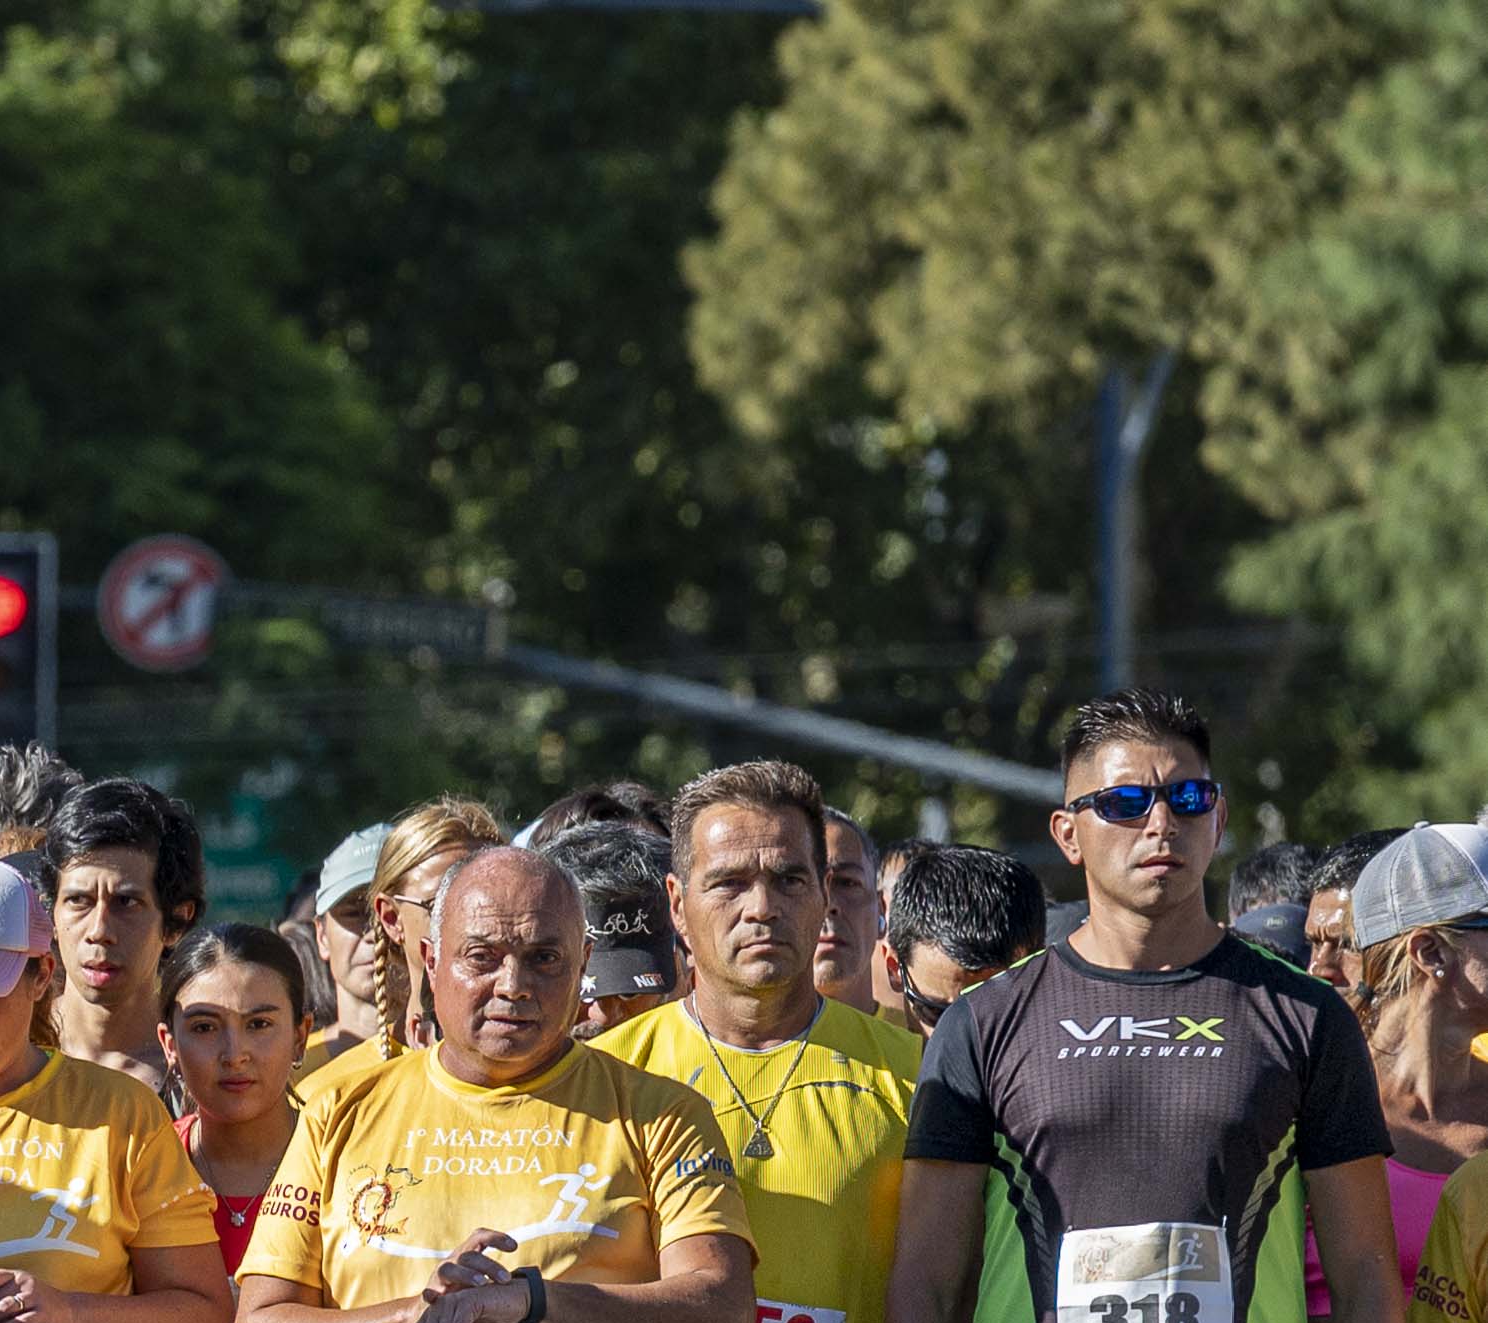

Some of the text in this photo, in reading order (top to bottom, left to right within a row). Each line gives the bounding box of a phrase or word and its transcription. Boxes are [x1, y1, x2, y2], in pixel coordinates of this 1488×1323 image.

[1059, 1016, 1226, 1041] VKX
[1057, 1045, 1226, 1060] SPORTSWEAR
[433, 1123, 576, 1149] MARATÓN
[421, 1156, 544, 1176] DORADA
